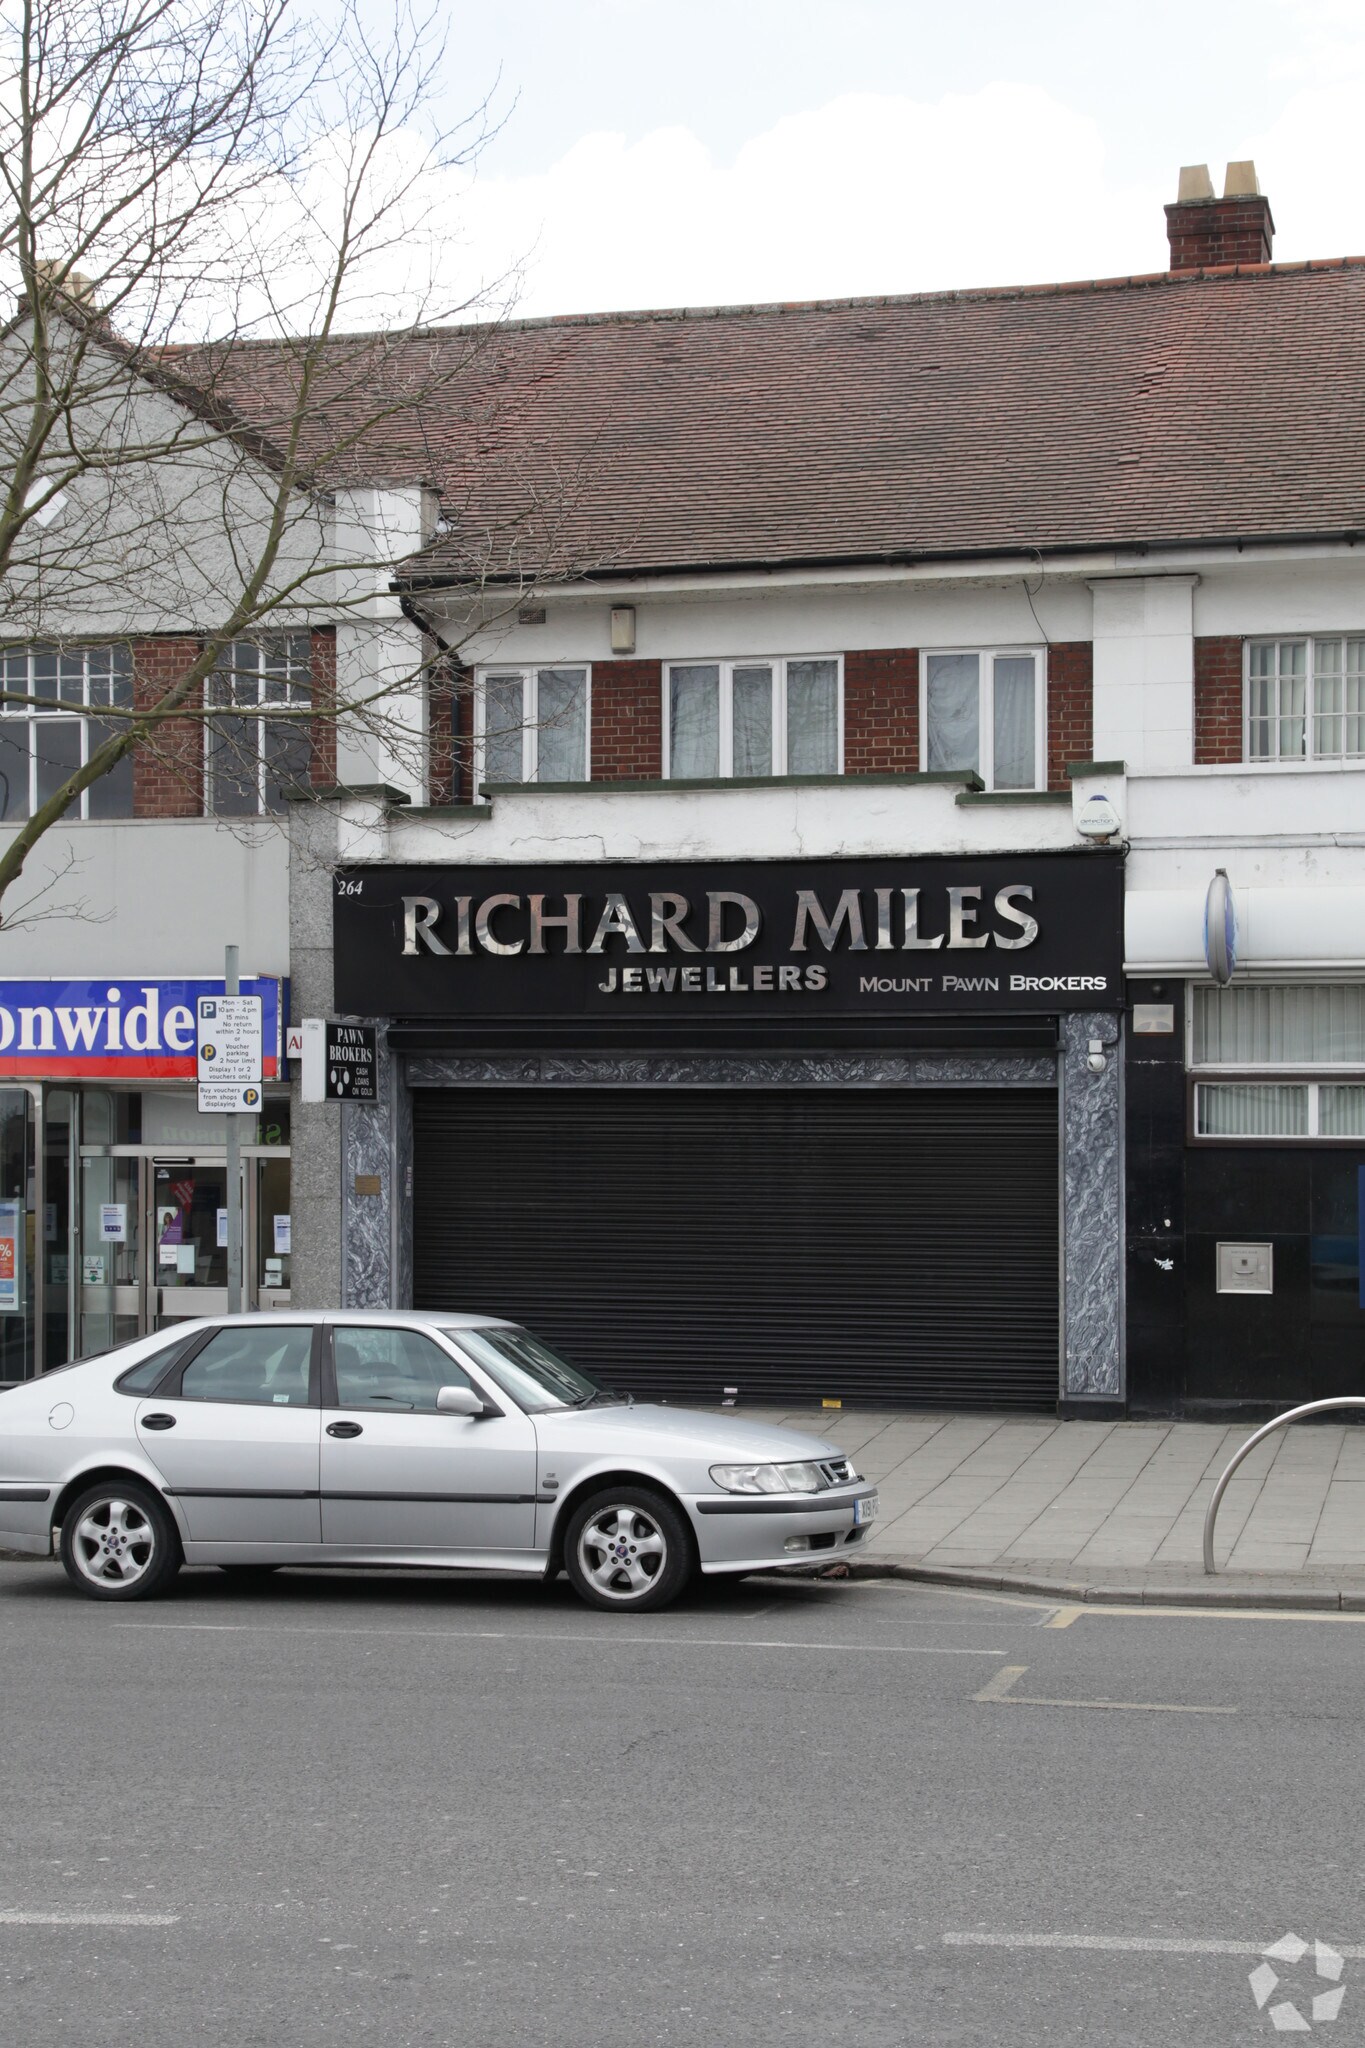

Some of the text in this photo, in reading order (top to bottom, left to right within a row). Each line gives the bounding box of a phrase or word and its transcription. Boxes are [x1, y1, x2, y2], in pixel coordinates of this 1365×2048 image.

[338, 881, 363, 895] 264
[401, 885, 1040, 956] RICHARD MILES
[599, 965, 829, 993] JEWELLERS
[337, 1027, 364, 1045] PAWN
[329, 1045, 373, 1063] BROKERS
[355, 1067, 369, 1075] CASH
[354, 1077, 370, 1086] LOANS
[352, 1087, 373, 1096] ON GOLD
